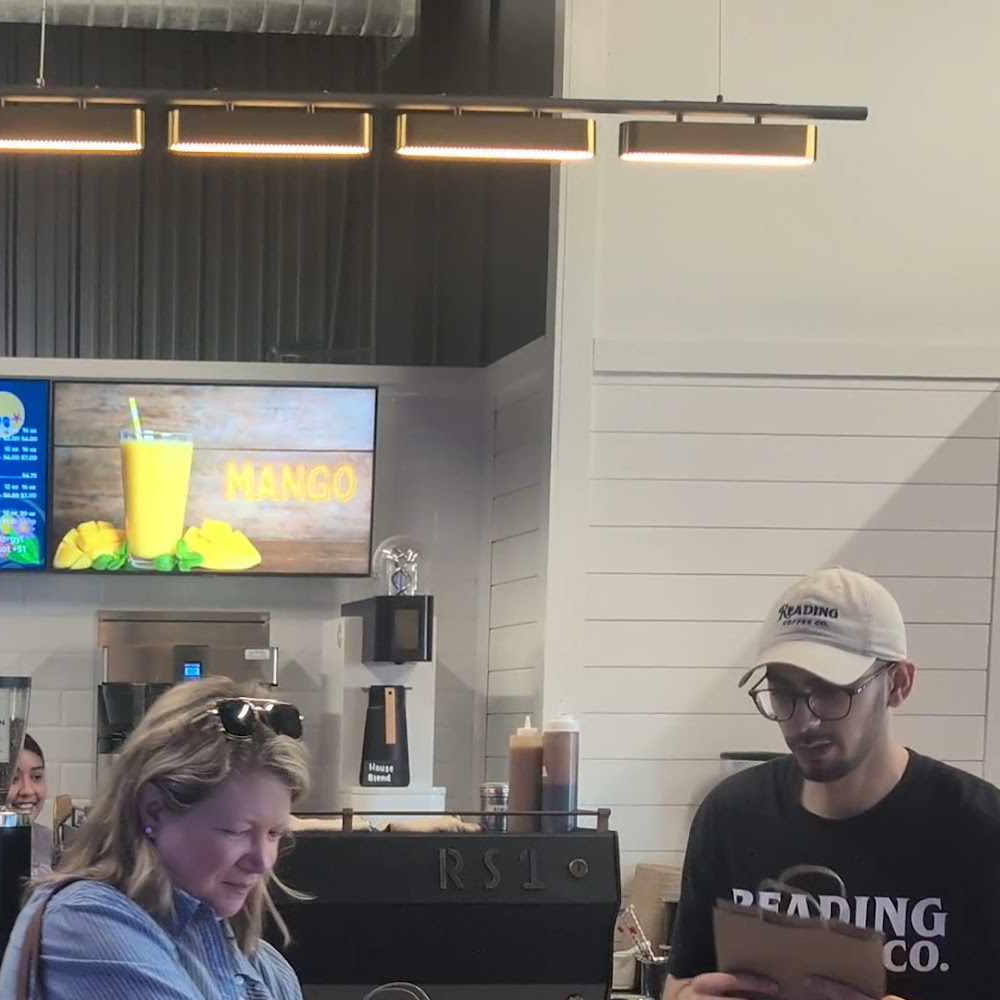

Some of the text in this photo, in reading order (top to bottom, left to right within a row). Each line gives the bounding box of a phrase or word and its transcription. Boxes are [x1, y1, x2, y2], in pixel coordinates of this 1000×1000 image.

[224, 460, 358, 502] MANGO
[777, 603, 839, 622] READING
[368, 762, 394, 773] House
[368, 773, 391, 782] Blend
[882, 940, 949, 972] CO.
